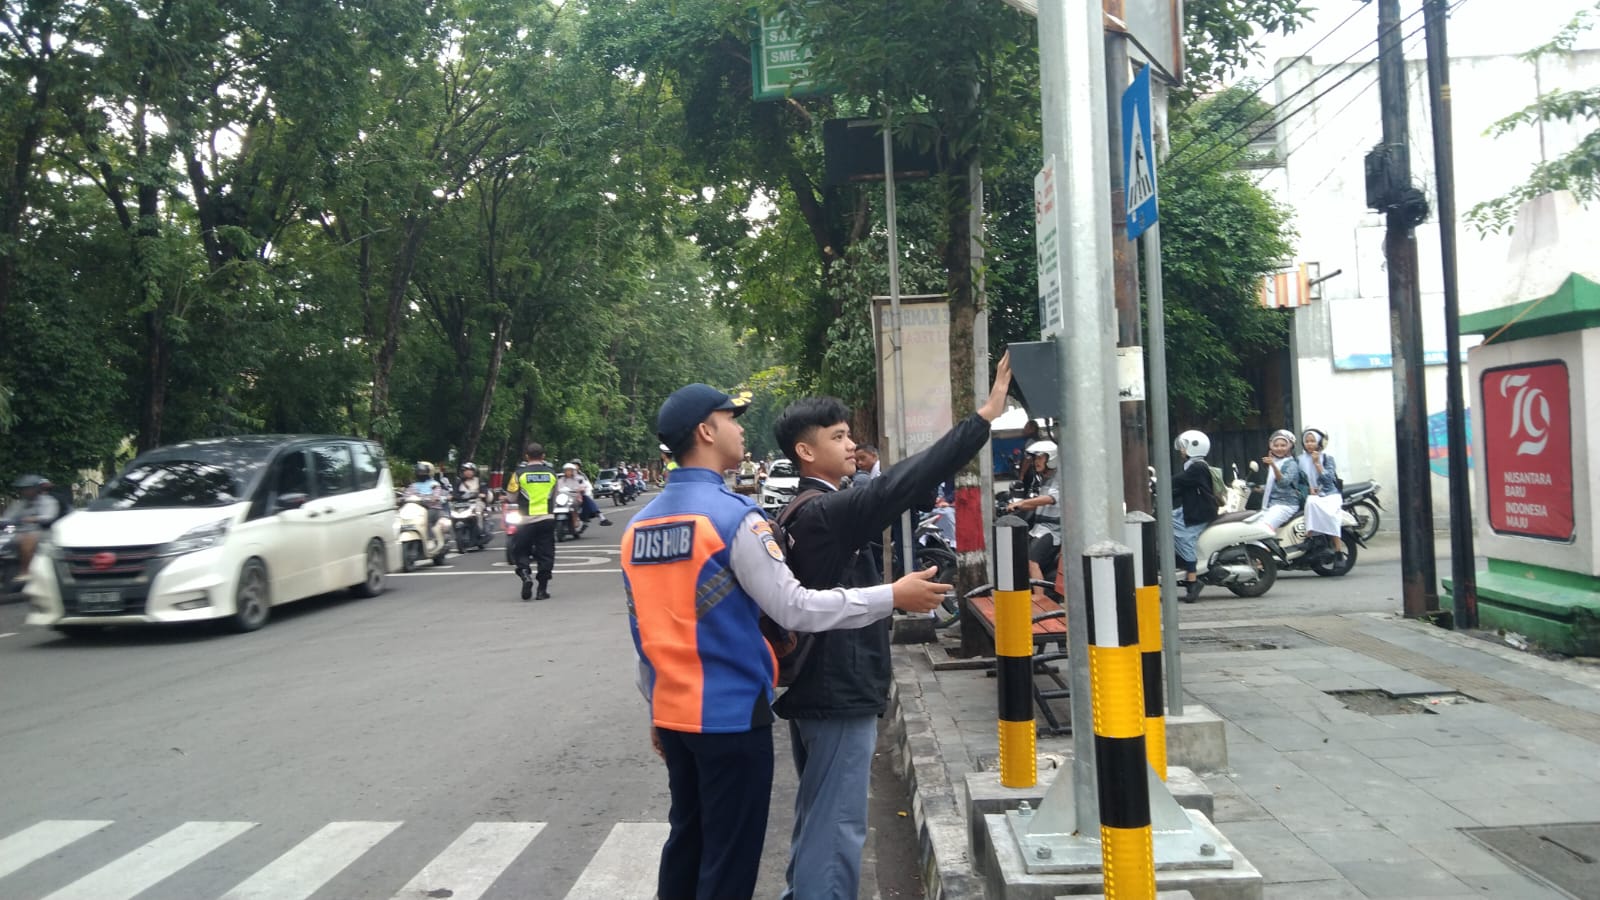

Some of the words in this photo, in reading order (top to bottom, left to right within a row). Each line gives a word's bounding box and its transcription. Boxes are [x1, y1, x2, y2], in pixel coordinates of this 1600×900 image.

[527, 474, 550, 482] POLISI
[1504, 472, 1552, 485] NUSANTARA
[1504, 485, 1526, 498] BARU
[1505, 502, 1548, 517] INDONESIA
[1506, 515, 1529, 529] MAJU
[633, 526, 691, 559] DISHUB
